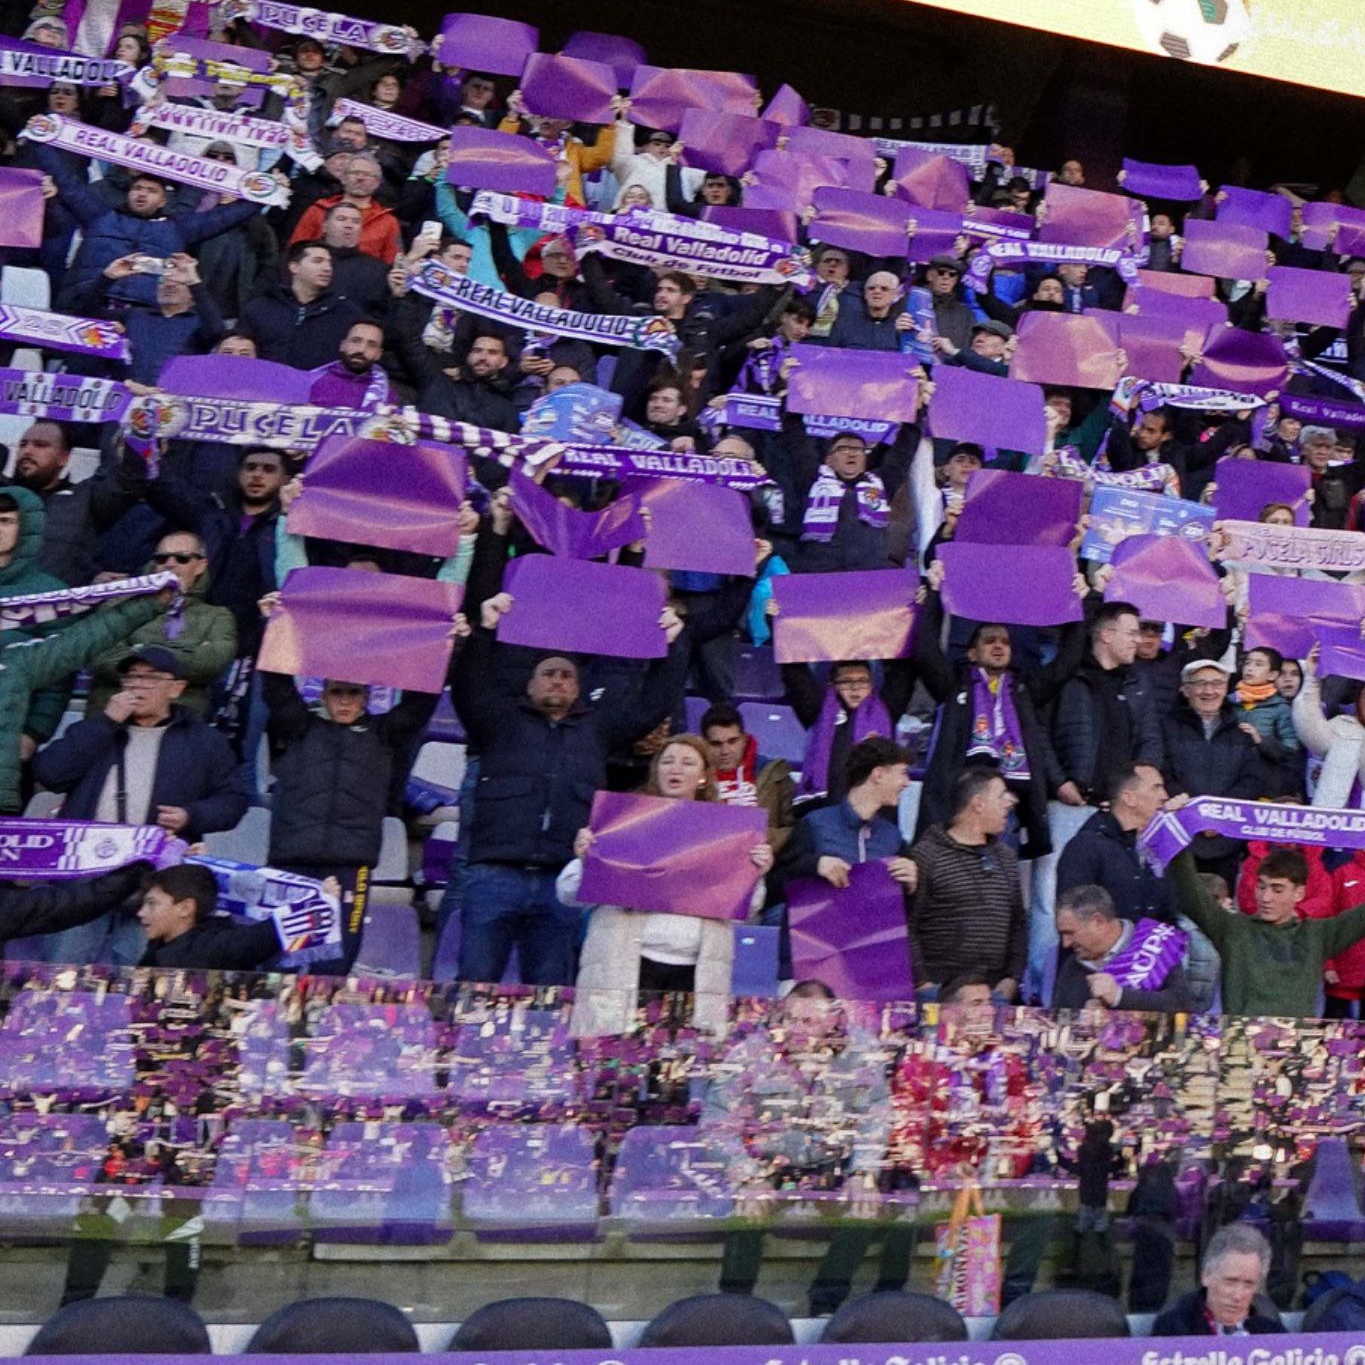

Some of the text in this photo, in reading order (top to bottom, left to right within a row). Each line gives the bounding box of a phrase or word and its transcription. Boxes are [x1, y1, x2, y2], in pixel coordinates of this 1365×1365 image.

[262, 3, 369, 44] PUCELA
[76, 128, 229, 182] REAL VALLADOLID
[611, 246, 652, 263] Club
[659, 255, 688, 269] de
[613, 226, 662, 249] Real
[665, 234, 770, 268] Valladolid
[456, 278, 629, 334] REAL VALLADOLID
[4, 381, 124, 412] VALLADOLID
[189, 404, 355, 436] PUCELA
[737, 403, 891, 434] REAL ALLADOLID
[1199, 802, 1247, 824] REAL
